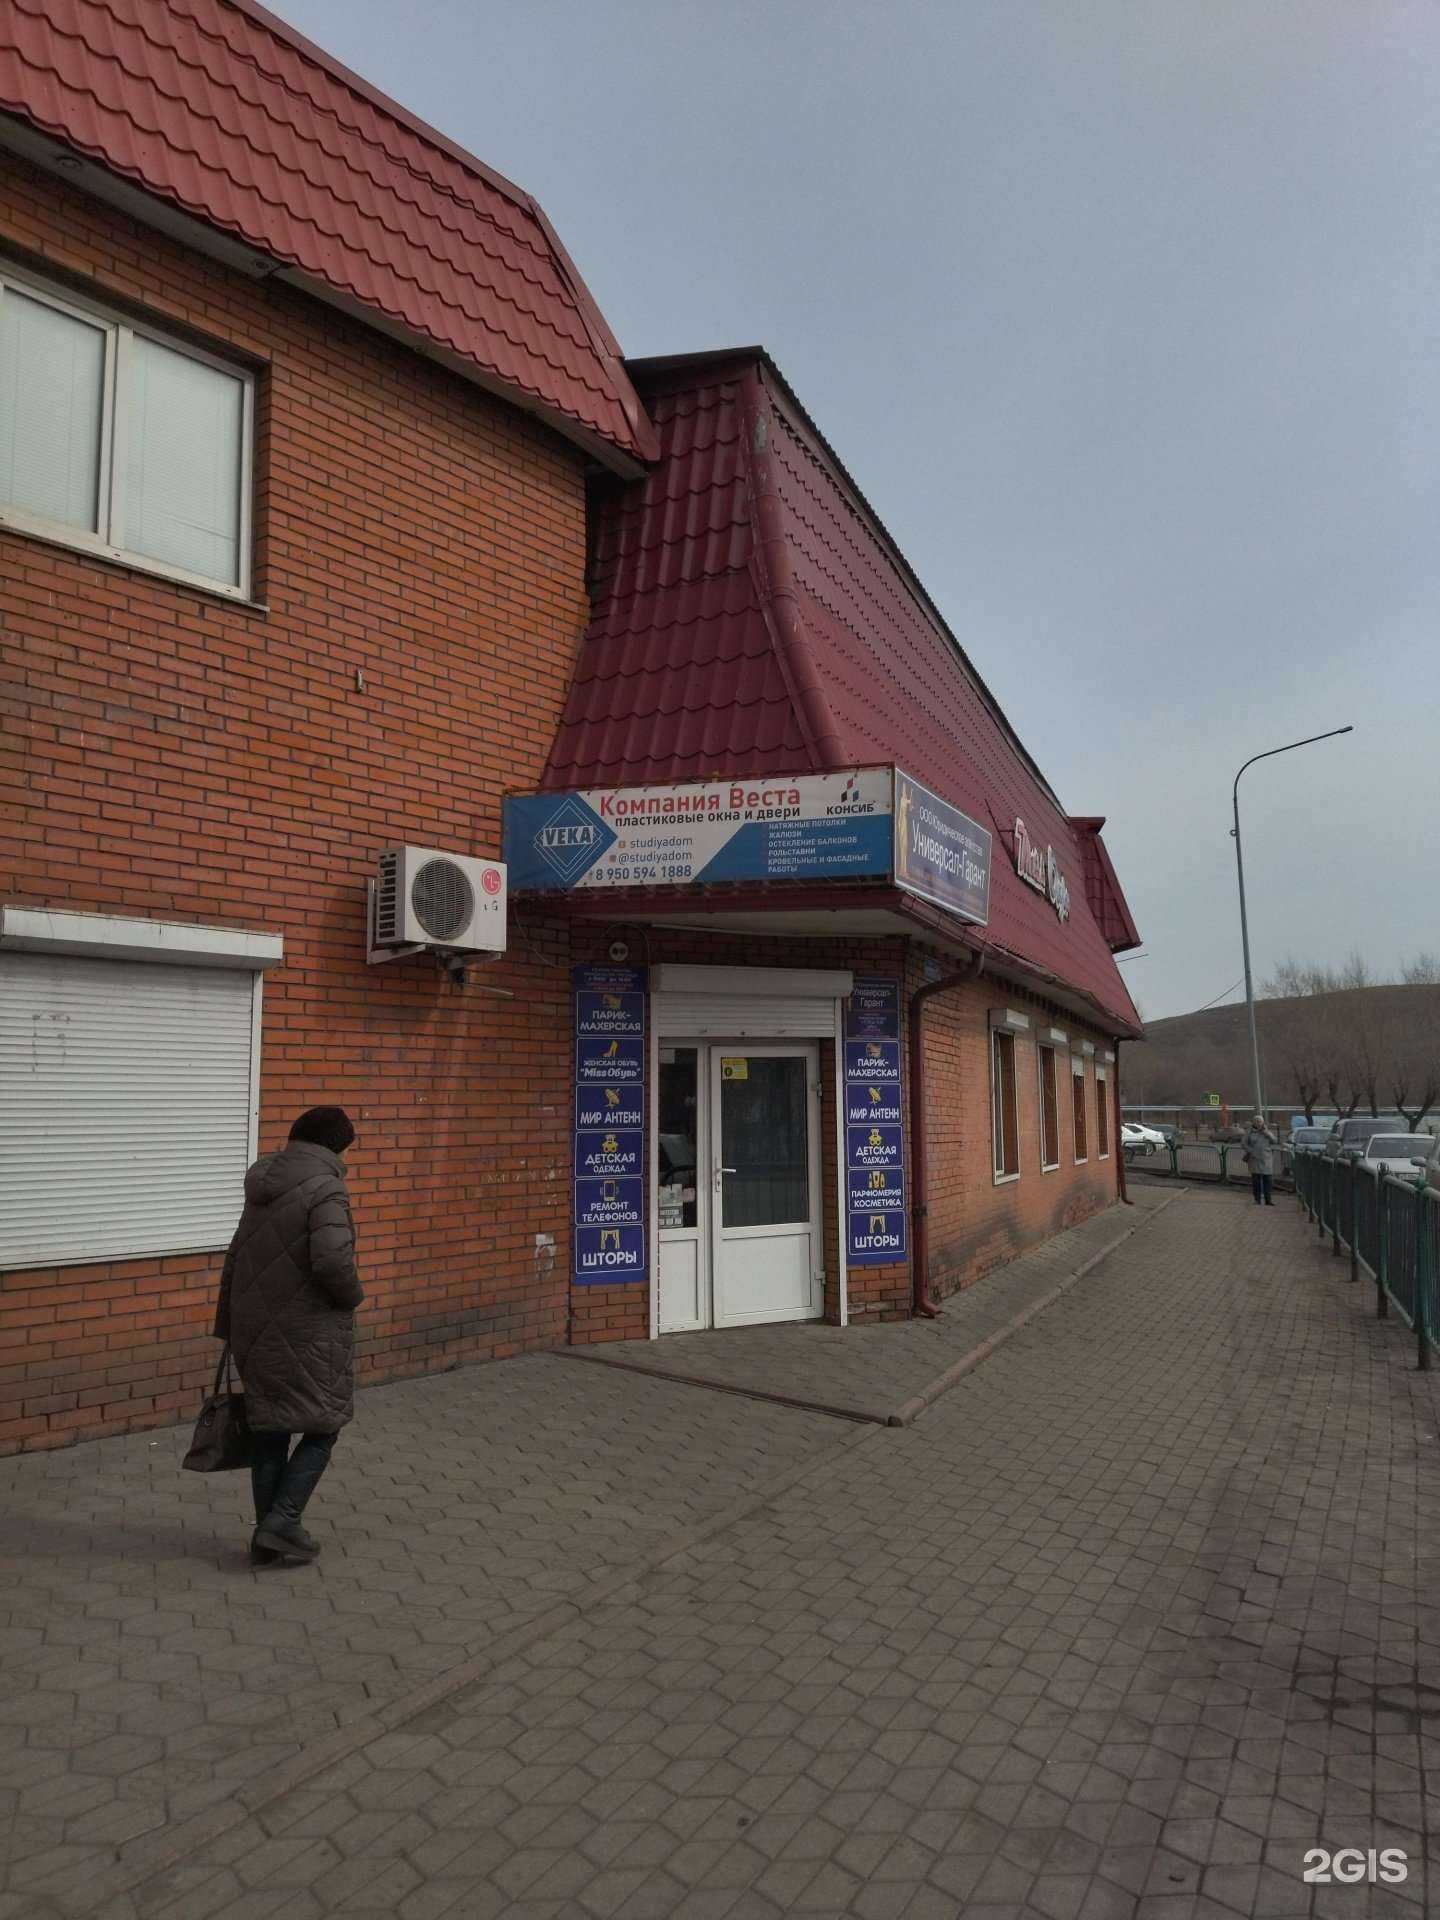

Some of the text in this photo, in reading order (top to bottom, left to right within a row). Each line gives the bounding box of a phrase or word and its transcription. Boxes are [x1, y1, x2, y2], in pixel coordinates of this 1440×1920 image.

[600, 787, 800, 817] Компания Веста
[826, 803, 875, 815] КОНСИБ
[615, 807, 800, 827] пластиковые окна и двери
[768, 821, 810, 830] НАТЯЖНЫЕ
[544, 826, 593, 846] VEKA
[768, 830, 802, 839] ЖАЛЮЗИ
[630, 836, 693, 850] studiyadom
[768, 836, 858, 848] ОСТЕКЛЕНИЕ БАЛКОНОВ
[618, 850, 692, 864] @studiyadom
[768, 848, 816, 857] РОЛЬСТАВНИ
[768, 856, 818, 866] КРОВЕЛЬНЫЕ
[826, 853, 869, 863] ФАСАДНЫЕ
[596, 864, 692, 881] 8 950 594 1888
[768, 865, 798, 873] РАБОТЫ
[592, 1010, 632, 1020] ПАРИК-
[580, 1021, 641, 1031] МАХЕРСКАЯ
[857, 1058, 889, 1067] ПАРИК-
[848, 1069, 898, 1077] МАХЕРСКАЯ
[580, 1111, 641, 1124] МИР АНТЕНН
[850, 1107, 900, 1119] МИР АНТЕНН
[856, 1145, 897, 1156] ДЕТСКАЯ
[585, 1152, 636, 1165] ДЕТСКАЯ
[862, 1156, 889, 1164] ОДЕЖДА
[593, 1165, 626, 1173] ОДЕЖДА
[851, 1188, 902, 1198] ПАРФЮМЕРИЯ
[590, 1201, 629, 1211] РЕМОНТ
[854, 1198, 902, 1208] КОСМЕТИКА
[582, 1211, 638, 1222] ТЕЛЕФОНОВ
[854, 1235, 899, 1248] ШТОРЫ
[582, 1250, 637, 1266] ШТОРЫ
